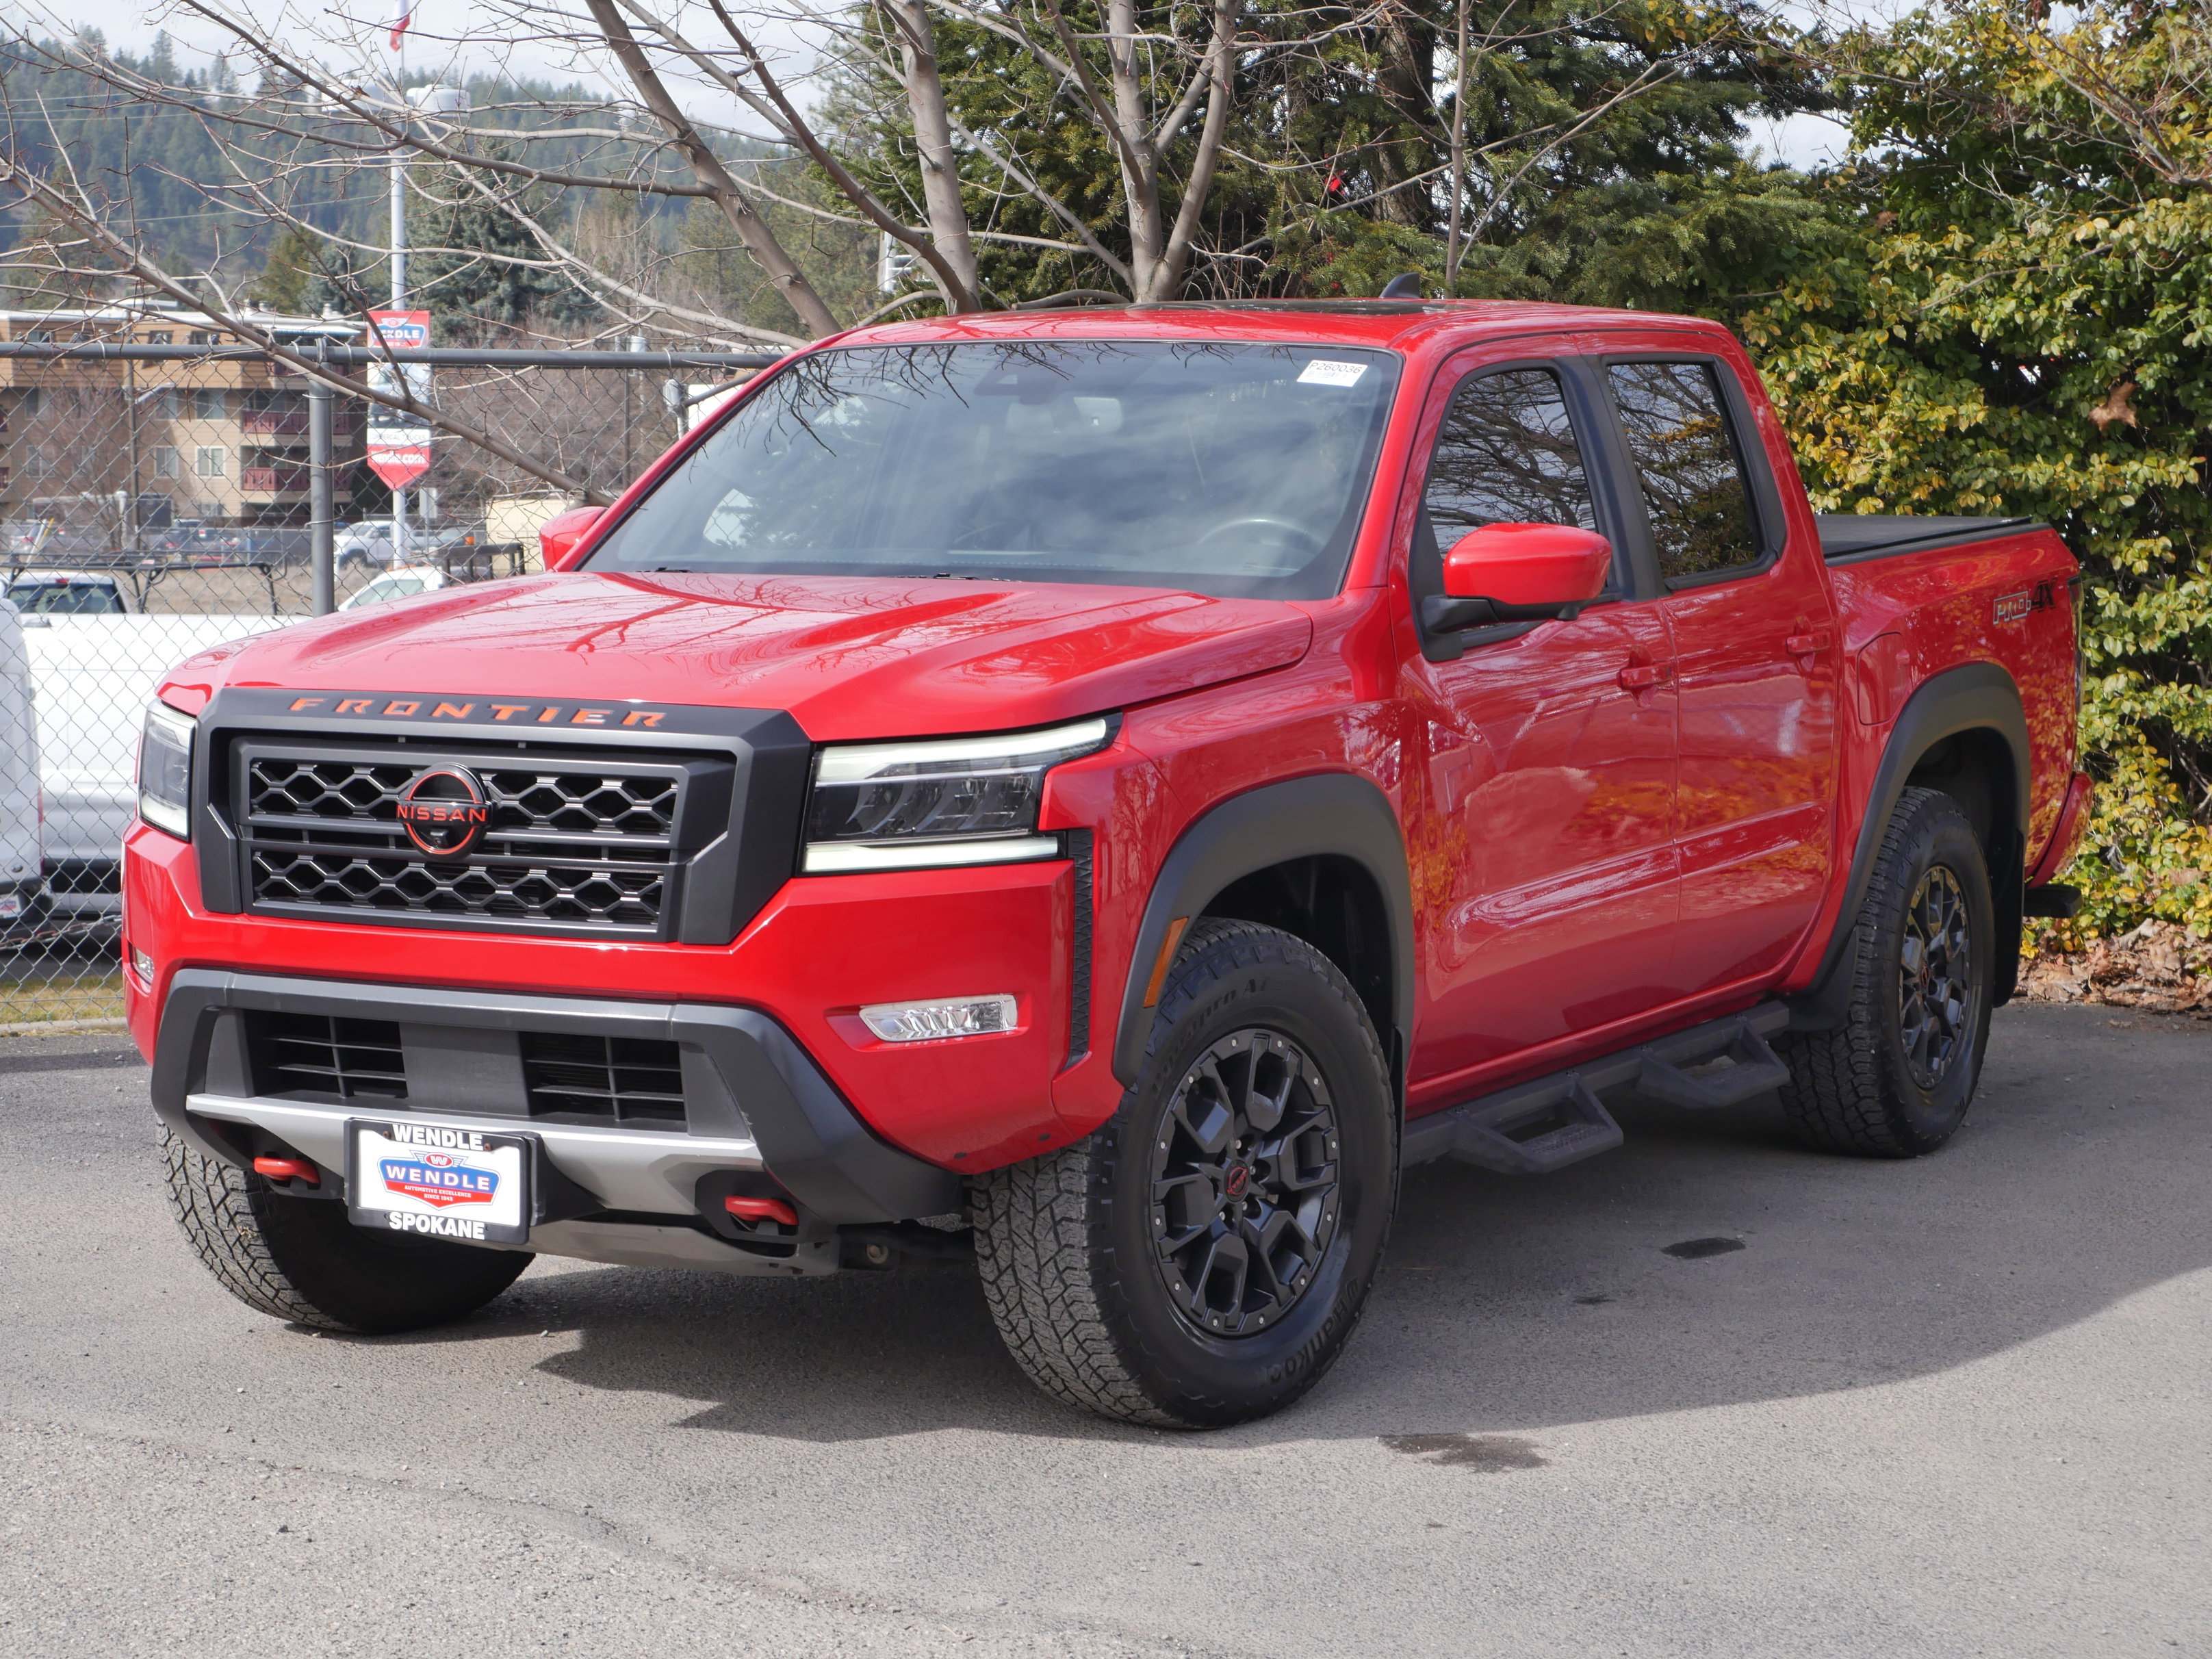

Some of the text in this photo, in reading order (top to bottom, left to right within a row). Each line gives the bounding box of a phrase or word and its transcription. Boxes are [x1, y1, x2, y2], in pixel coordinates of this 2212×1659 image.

[1309, 362, 1363, 374] P260036
[288, 697, 667, 728] FRONTIER
[396, 804, 487, 822] NISSAN
[391, 1124, 484, 1151] WENDLE
[430, 1155, 448, 1166] W
[385, 1165, 490, 1191] WENDLE
[404, 1185, 472, 1198] AUTOMOTIVE EXCELLENCE
[389, 1211, 485, 1240] SPOKANE
